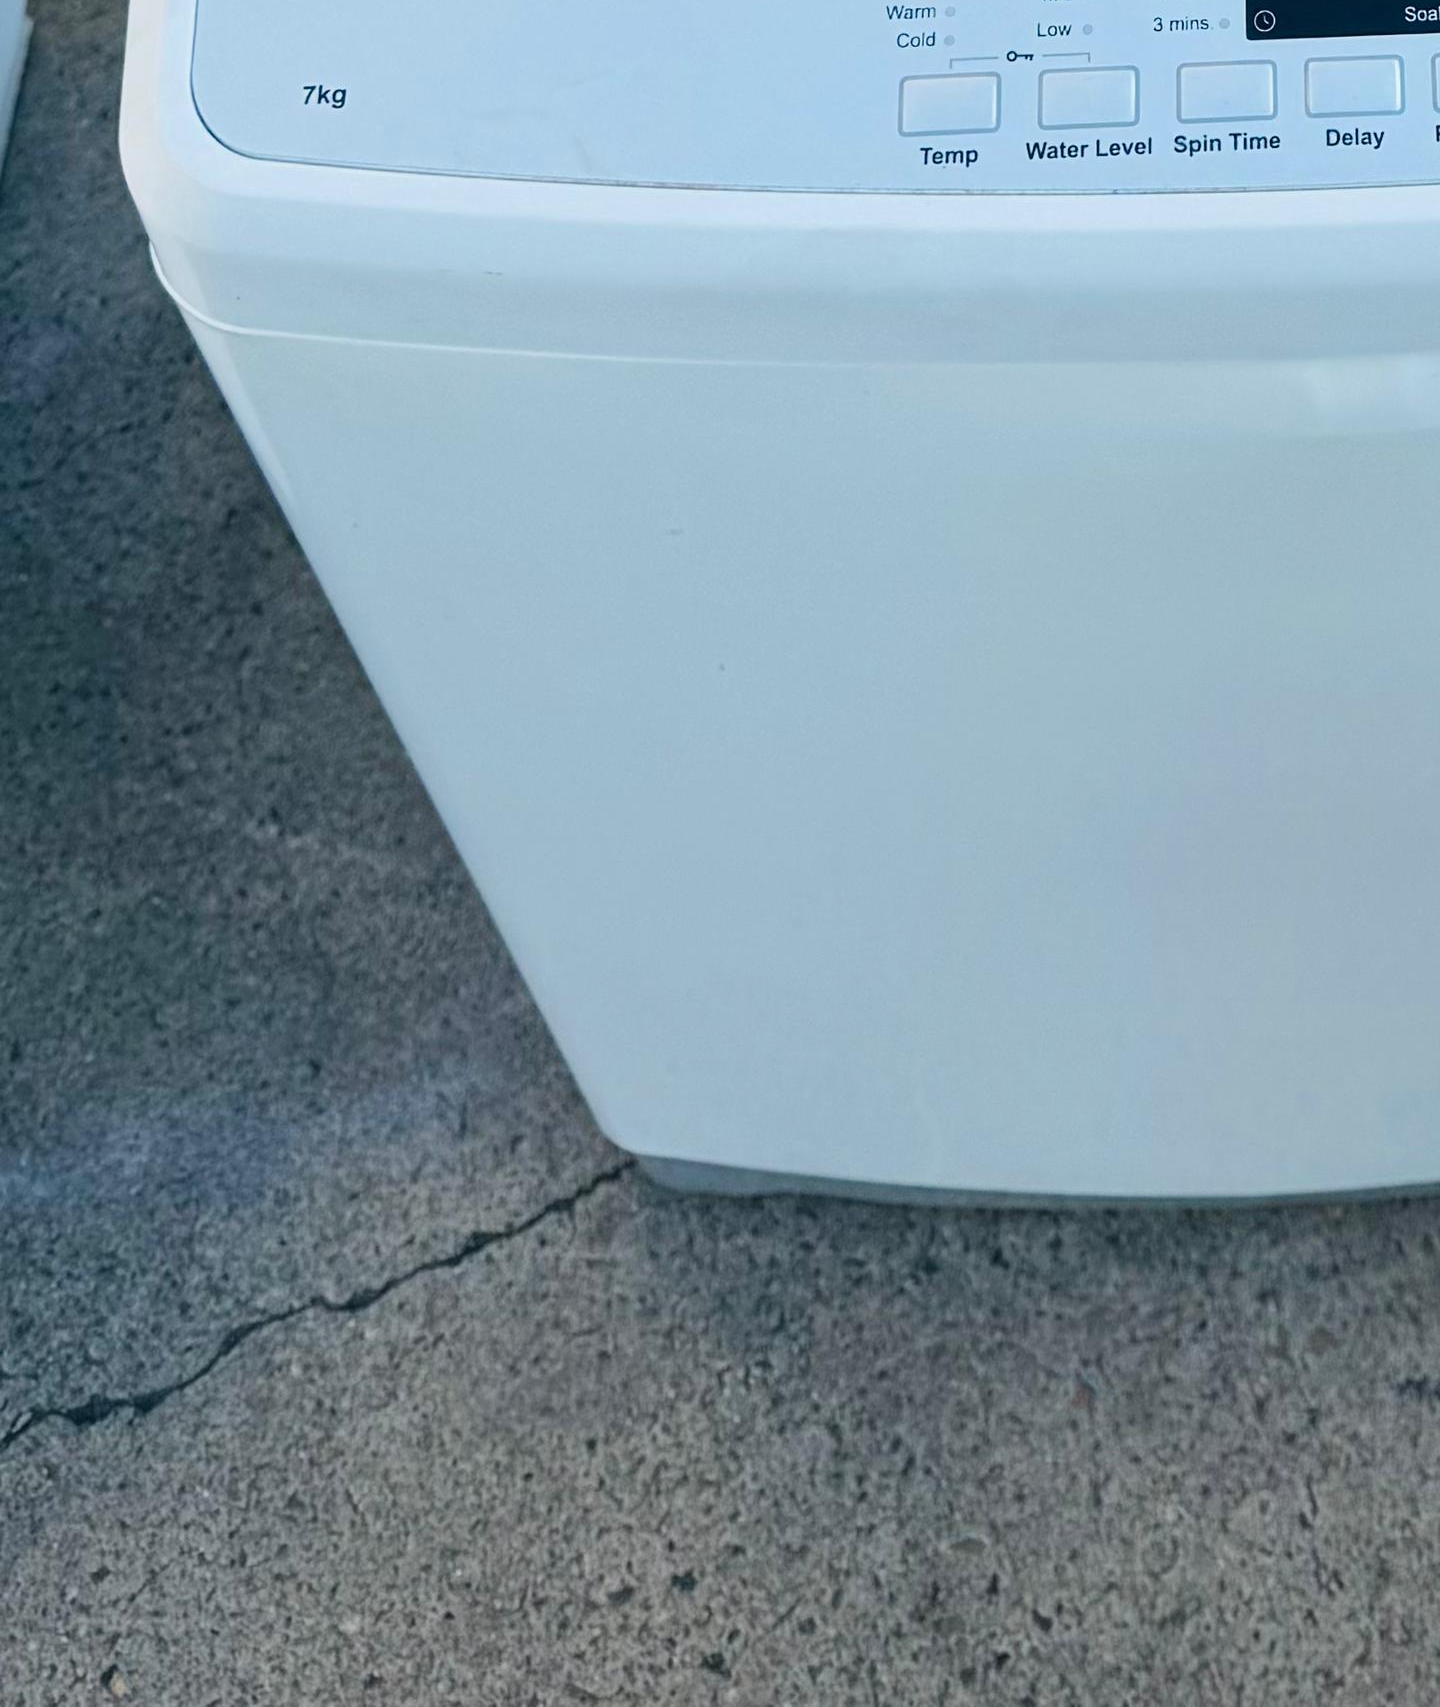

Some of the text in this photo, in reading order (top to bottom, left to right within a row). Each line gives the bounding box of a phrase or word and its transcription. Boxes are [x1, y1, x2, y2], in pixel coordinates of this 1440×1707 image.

[886, 5, 937, 20] Warm
[1037, 22, 1072, 38] Low
[1153, 17, 1164, 32] 3
[896, 31, 936, 49] Cold
[303, 84, 347, 109] 7kg
[1025, 136, 1153, 161] Water Level
[1173, 132, 1281, 158] Spin Time
[1325, 127, 1385, 150] Delay
[919, 146, 979, 168] Temp
